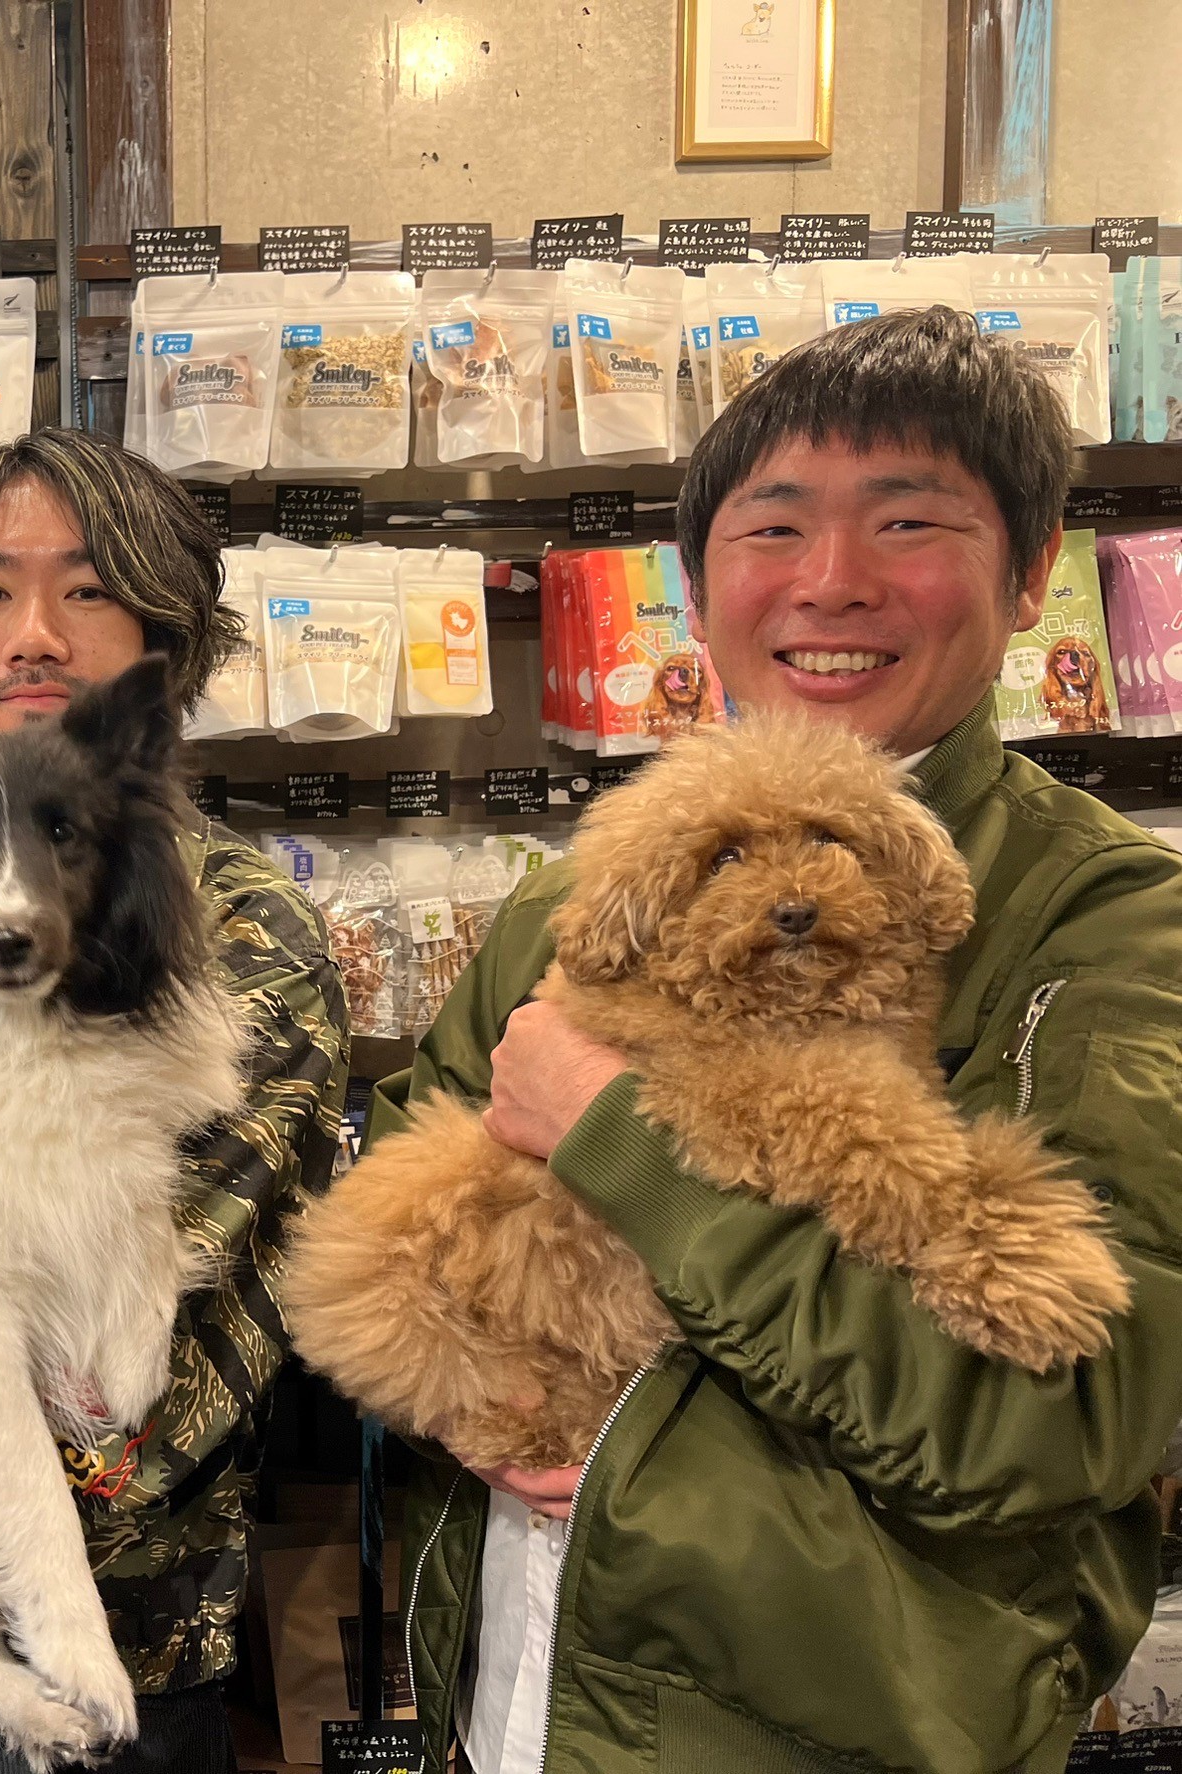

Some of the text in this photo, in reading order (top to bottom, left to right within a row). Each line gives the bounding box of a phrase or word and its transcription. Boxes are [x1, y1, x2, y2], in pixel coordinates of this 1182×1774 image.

[787, 217, 831, 229] スマイリー
[913, 215, 959, 227] スマイリー
[265, 229, 308, 238] スマイリー
[409, 226, 452, 236] スマイリー
[540, 223, 589, 235] スマイリー
[668, 223, 719, 234] スマイリー
[136, 231, 178, 241] スマイリー
[608, 351, 664, 380] Smiley
[176, 363, 244, 391] Smiley
[312, 360, 381, 391] Smiley
[285, 489, 339, 502] スマイリー
[637, 602, 685, 621] Smiley
[300, 623, 369, 650] Smiley
